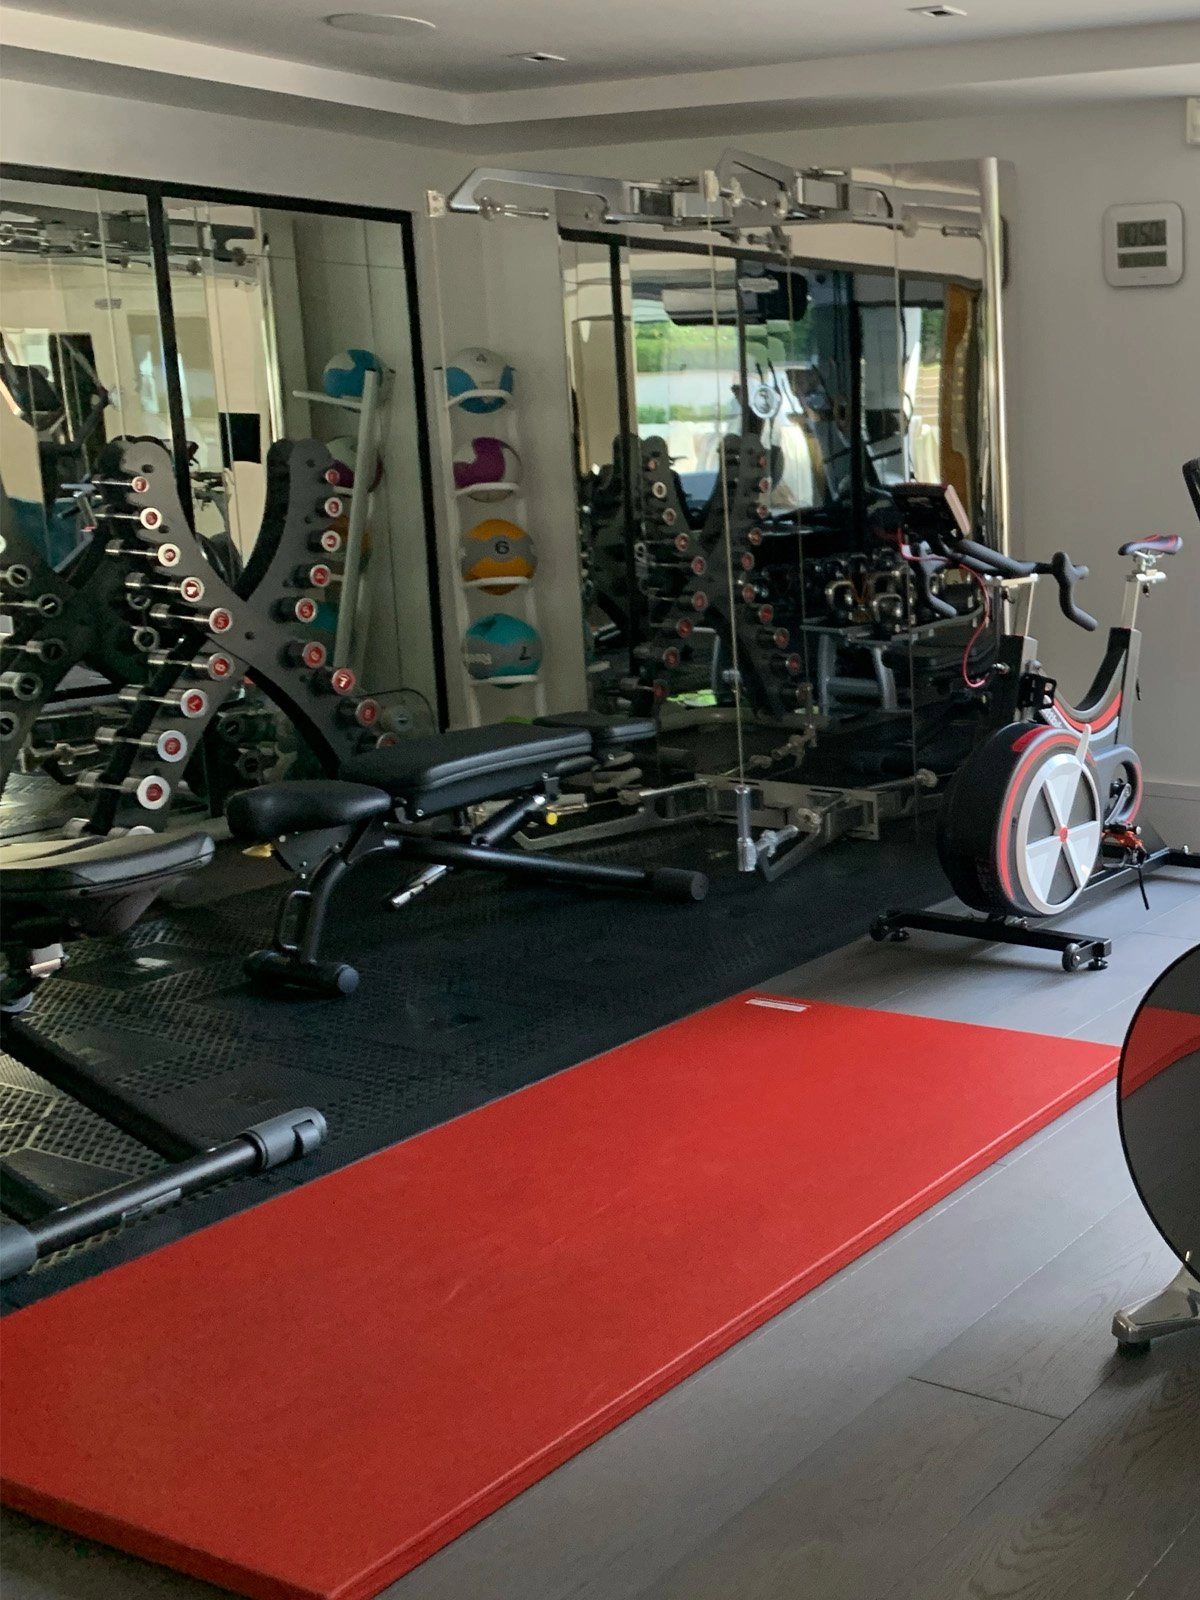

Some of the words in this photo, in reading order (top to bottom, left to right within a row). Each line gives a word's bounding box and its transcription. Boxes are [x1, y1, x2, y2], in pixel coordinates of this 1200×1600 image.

[495, 541, 509, 554] 6
[217, 615, 225, 627] 5
[519, 646, 531, 660] 7
[338, 673, 349, 688] 7
[188, 697, 200, 711] 7
